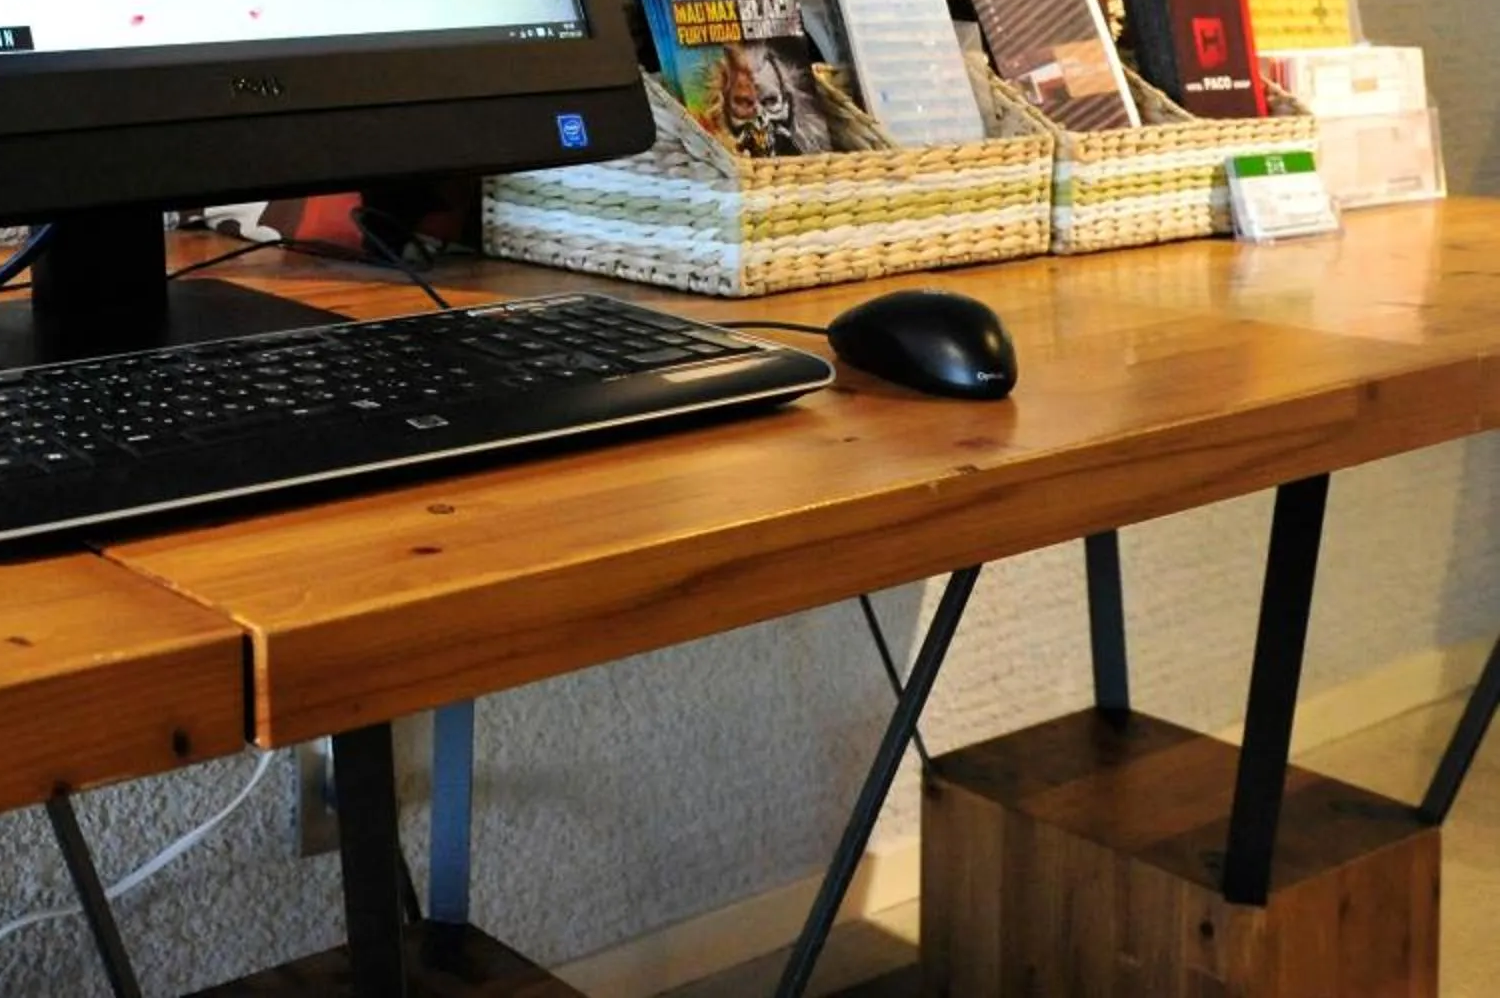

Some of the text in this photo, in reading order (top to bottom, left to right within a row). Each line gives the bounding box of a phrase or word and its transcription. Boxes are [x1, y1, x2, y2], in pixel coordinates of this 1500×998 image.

[674, 0, 737, 24] MAD MAX
[678, 21, 741, 45] FURY ROAD
[1203, 76, 1233, 91] PACO
